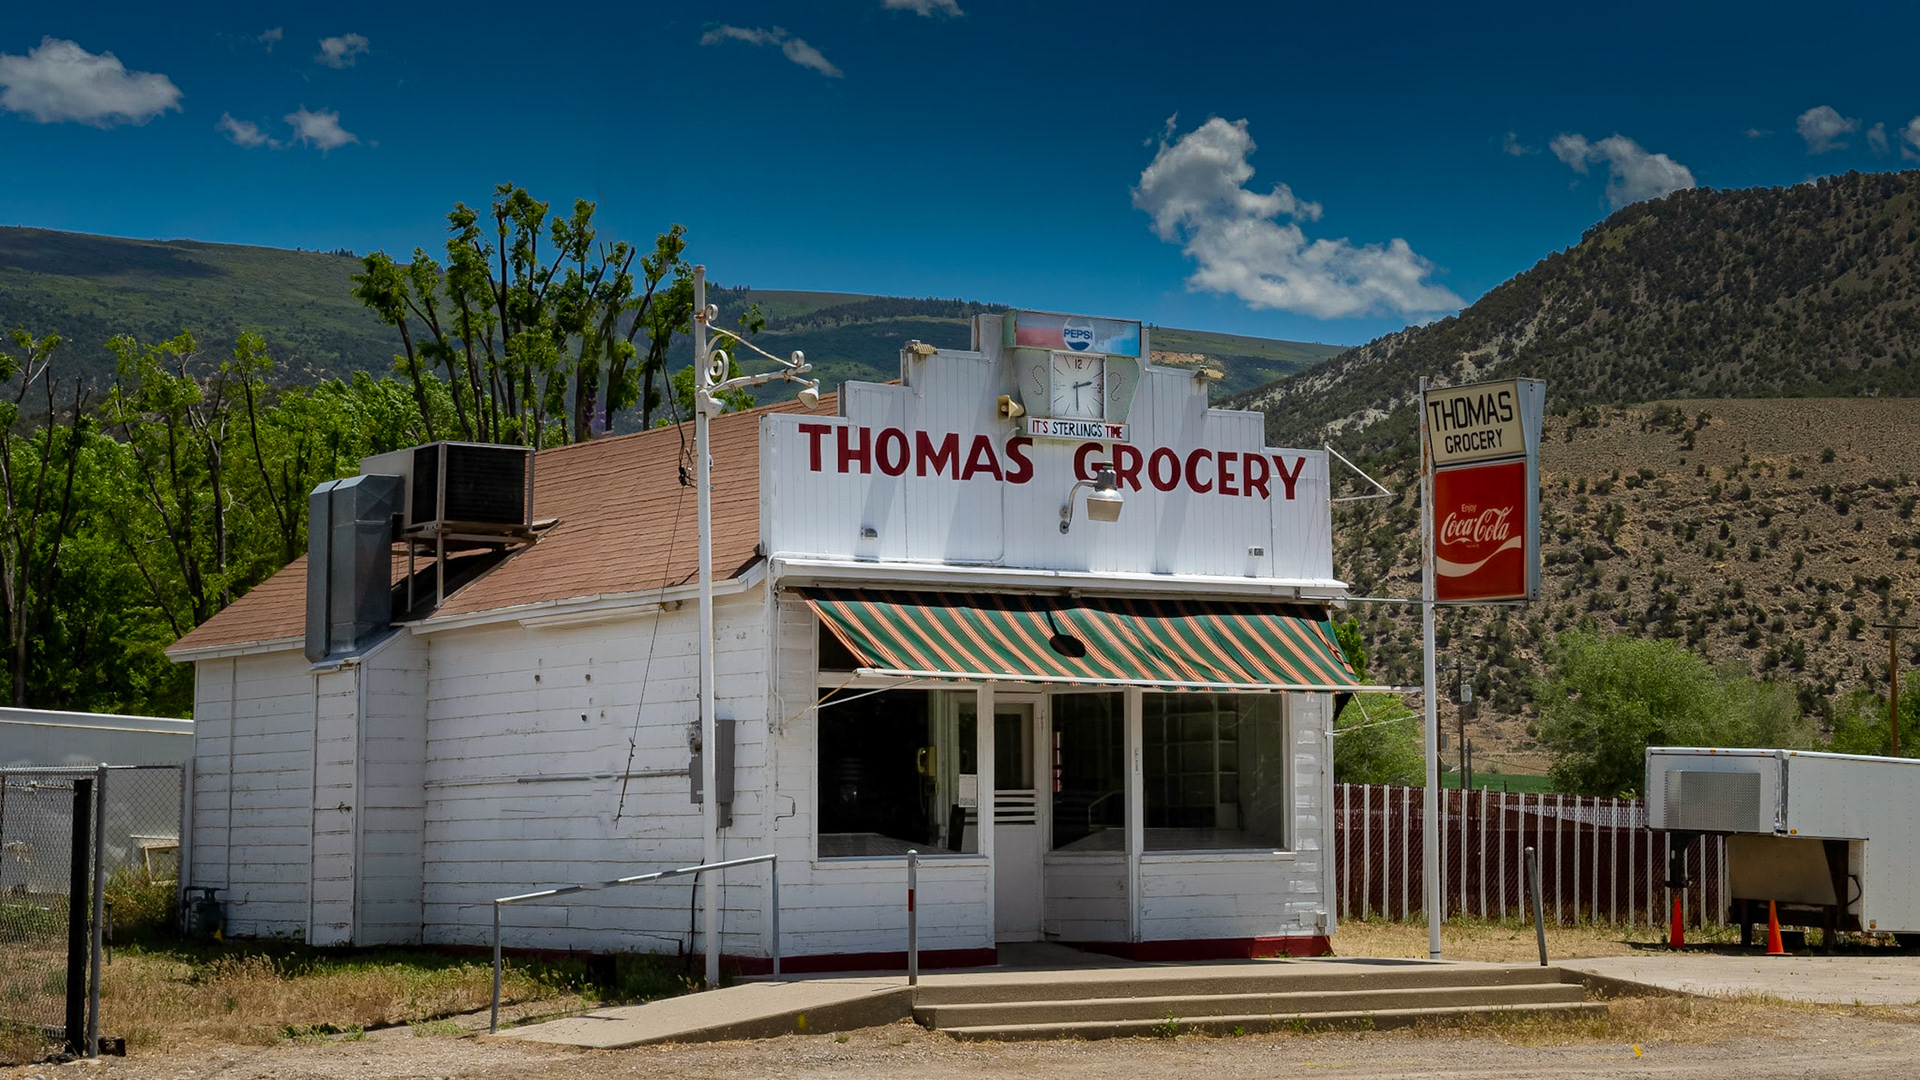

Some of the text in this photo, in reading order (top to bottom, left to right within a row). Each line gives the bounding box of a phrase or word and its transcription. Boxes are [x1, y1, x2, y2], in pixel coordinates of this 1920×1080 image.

[1063, 328, 1093, 340] PEPSI
[1075, 359, 1083, 370] 12
[1429, 391, 1513, 432] THOMAS
[1052, 421, 1103, 438] STERLING'S
[1445, 428, 1502, 454] GROCERY
[799, 423, 1306, 499] THOMAS GROCERY
[1461, 503, 1477, 513] Enjoy
